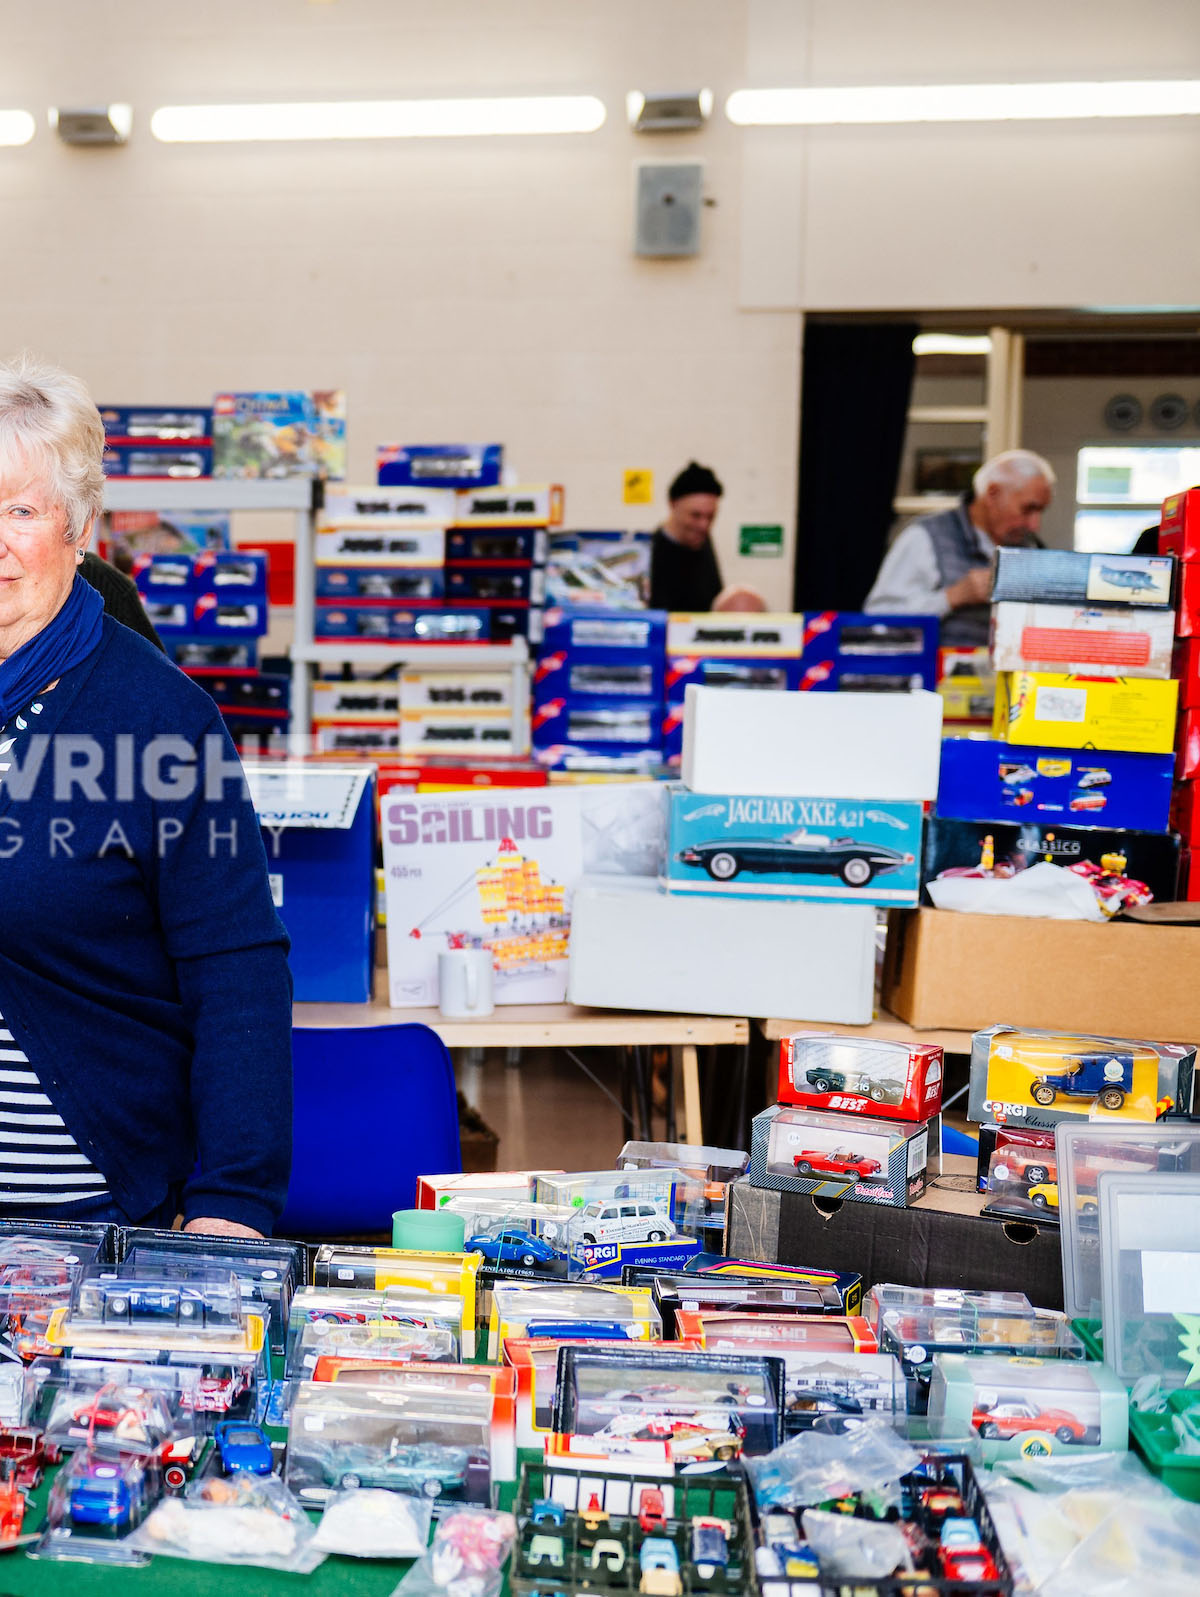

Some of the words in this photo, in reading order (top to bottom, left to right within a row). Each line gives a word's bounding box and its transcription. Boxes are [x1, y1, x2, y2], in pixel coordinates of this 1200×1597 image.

[724, 799, 794, 828] JAGUAR
[797, 801, 837, 827] XKE
[853, 1082, 870, 1091] 216
[828, 1095, 868, 1111] BEST
[982, 1100, 1027, 1117] CORGI
[634, 1256, 658, 1265] EVENING
[658, 1255, 686, 1263] STANDARD
